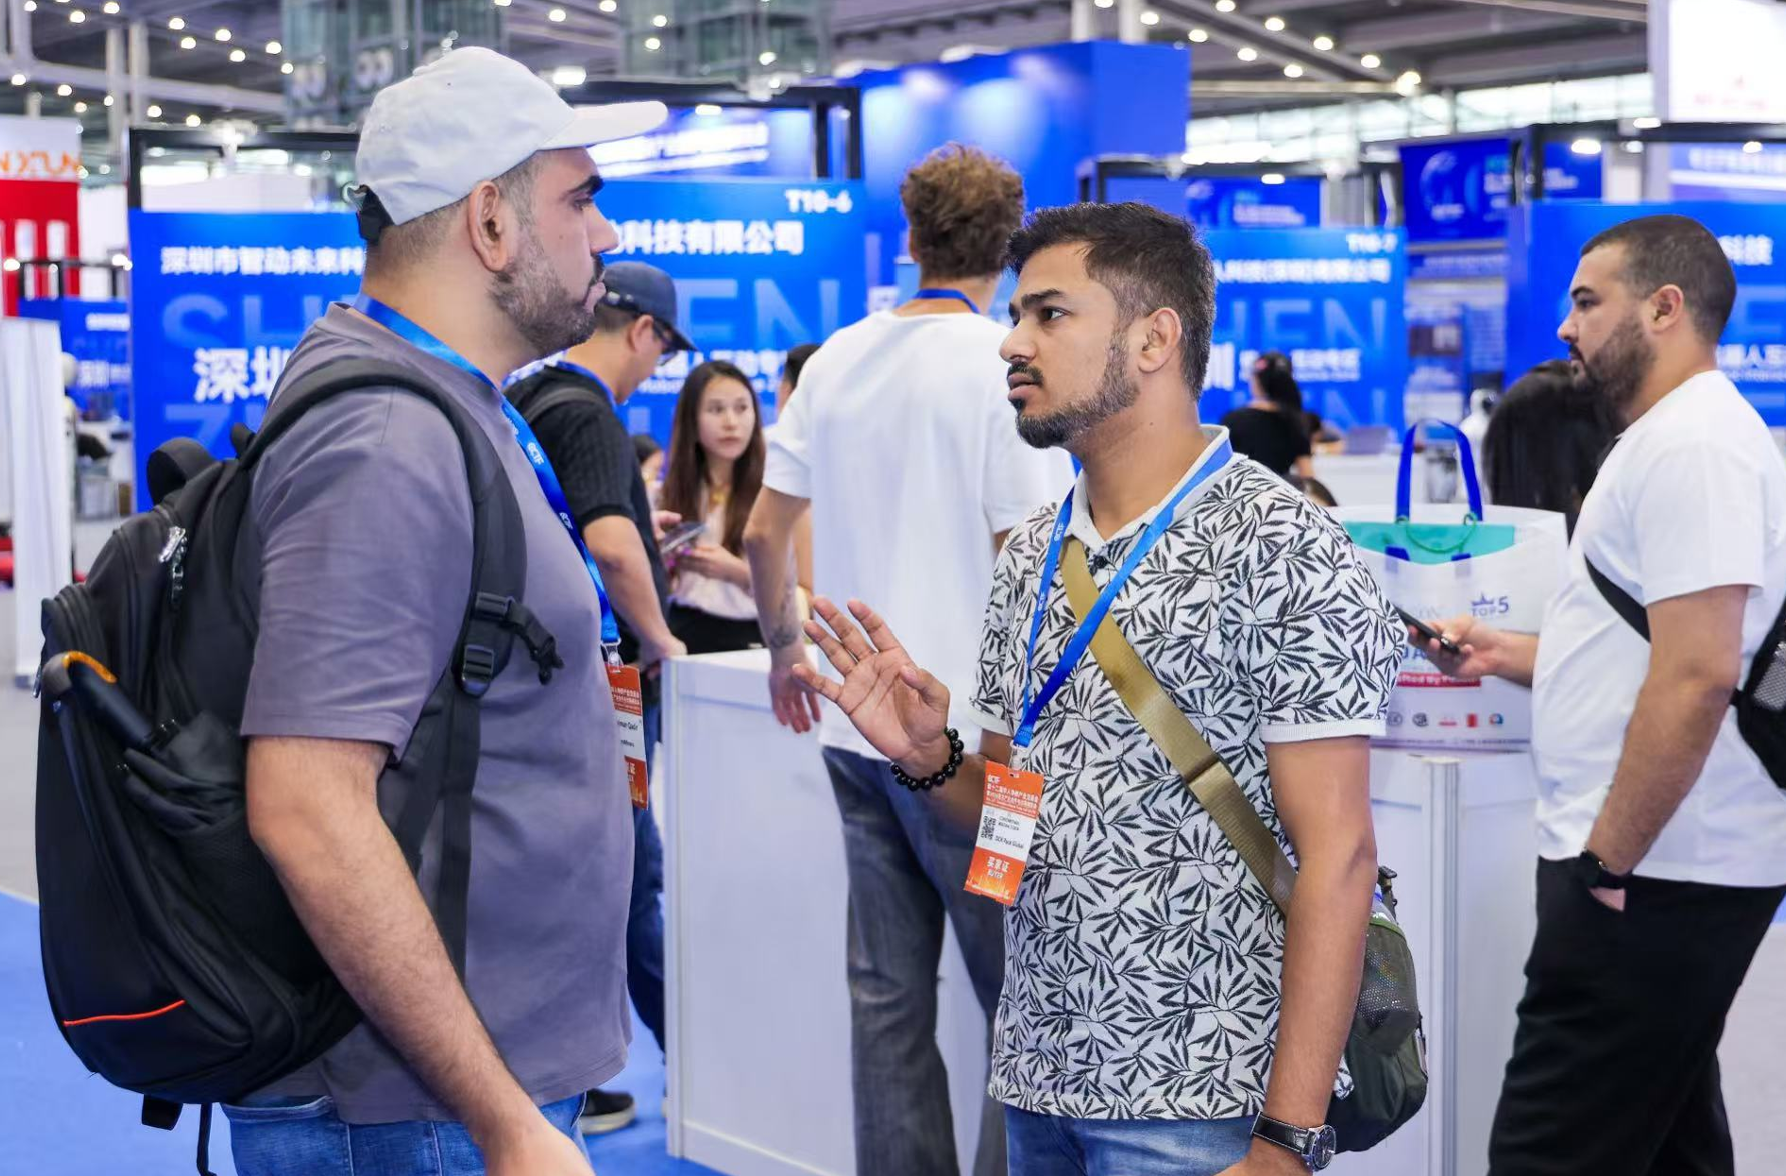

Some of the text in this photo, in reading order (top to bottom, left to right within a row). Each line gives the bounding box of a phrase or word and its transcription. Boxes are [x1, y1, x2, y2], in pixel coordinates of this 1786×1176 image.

[609, 219, 804, 255] 科技有限公司
[1498, 596, 1509, 613] 5
